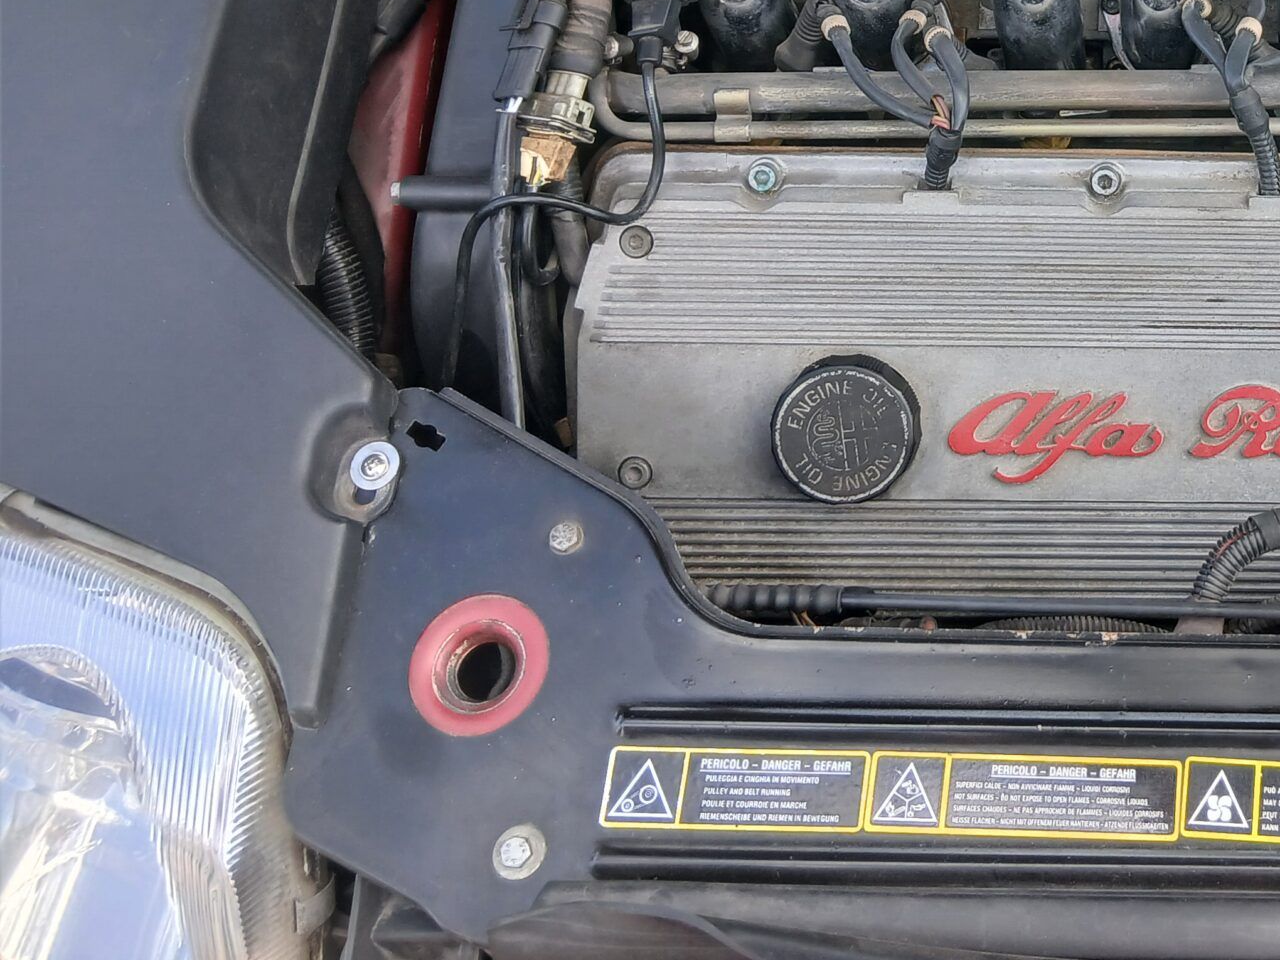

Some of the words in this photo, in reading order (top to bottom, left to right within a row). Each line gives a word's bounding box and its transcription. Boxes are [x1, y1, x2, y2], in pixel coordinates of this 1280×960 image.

[787, 380, 853, 430] ENGINE
[946, 390, 1165, 485] Alfa
[701, 758, 749, 770] PERICOLO
[761, 759, 801, 771] DANGER
[813, 761, 851, 772] GEFAHR
[991, 764, 1037, 777] PERICOLO
[1049, 766, 1088, 778] DANGER
[1099, 768, 1136, 779] GEFAHR
[705, 775, 737, 783] PULEGGIA
[780, 776, 820, 785] MOVIMENTO
[703, 787, 728, 795] PULLEY
[729, 787, 743, 795] AND
[744, 788, 760, 796] BELT
[761, 788, 791, 797] RUNNING
[701, 800, 725, 808] POULIE
[726, 800, 734, 808] ET
[735, 800, 769, 809] COURROIE
[770, 801, 779, 809] EN
[780, 801, 807, 809] MARCHE
[1263, 799, 1277, 807] MAY
[699, 812, 751, 821] RIEMENSCHEIBE
[752, 813, 767, 821] UND
[768, 814, 793, 822] RIEMEN
[802, 815, 839, 823] BEWEGUNG
